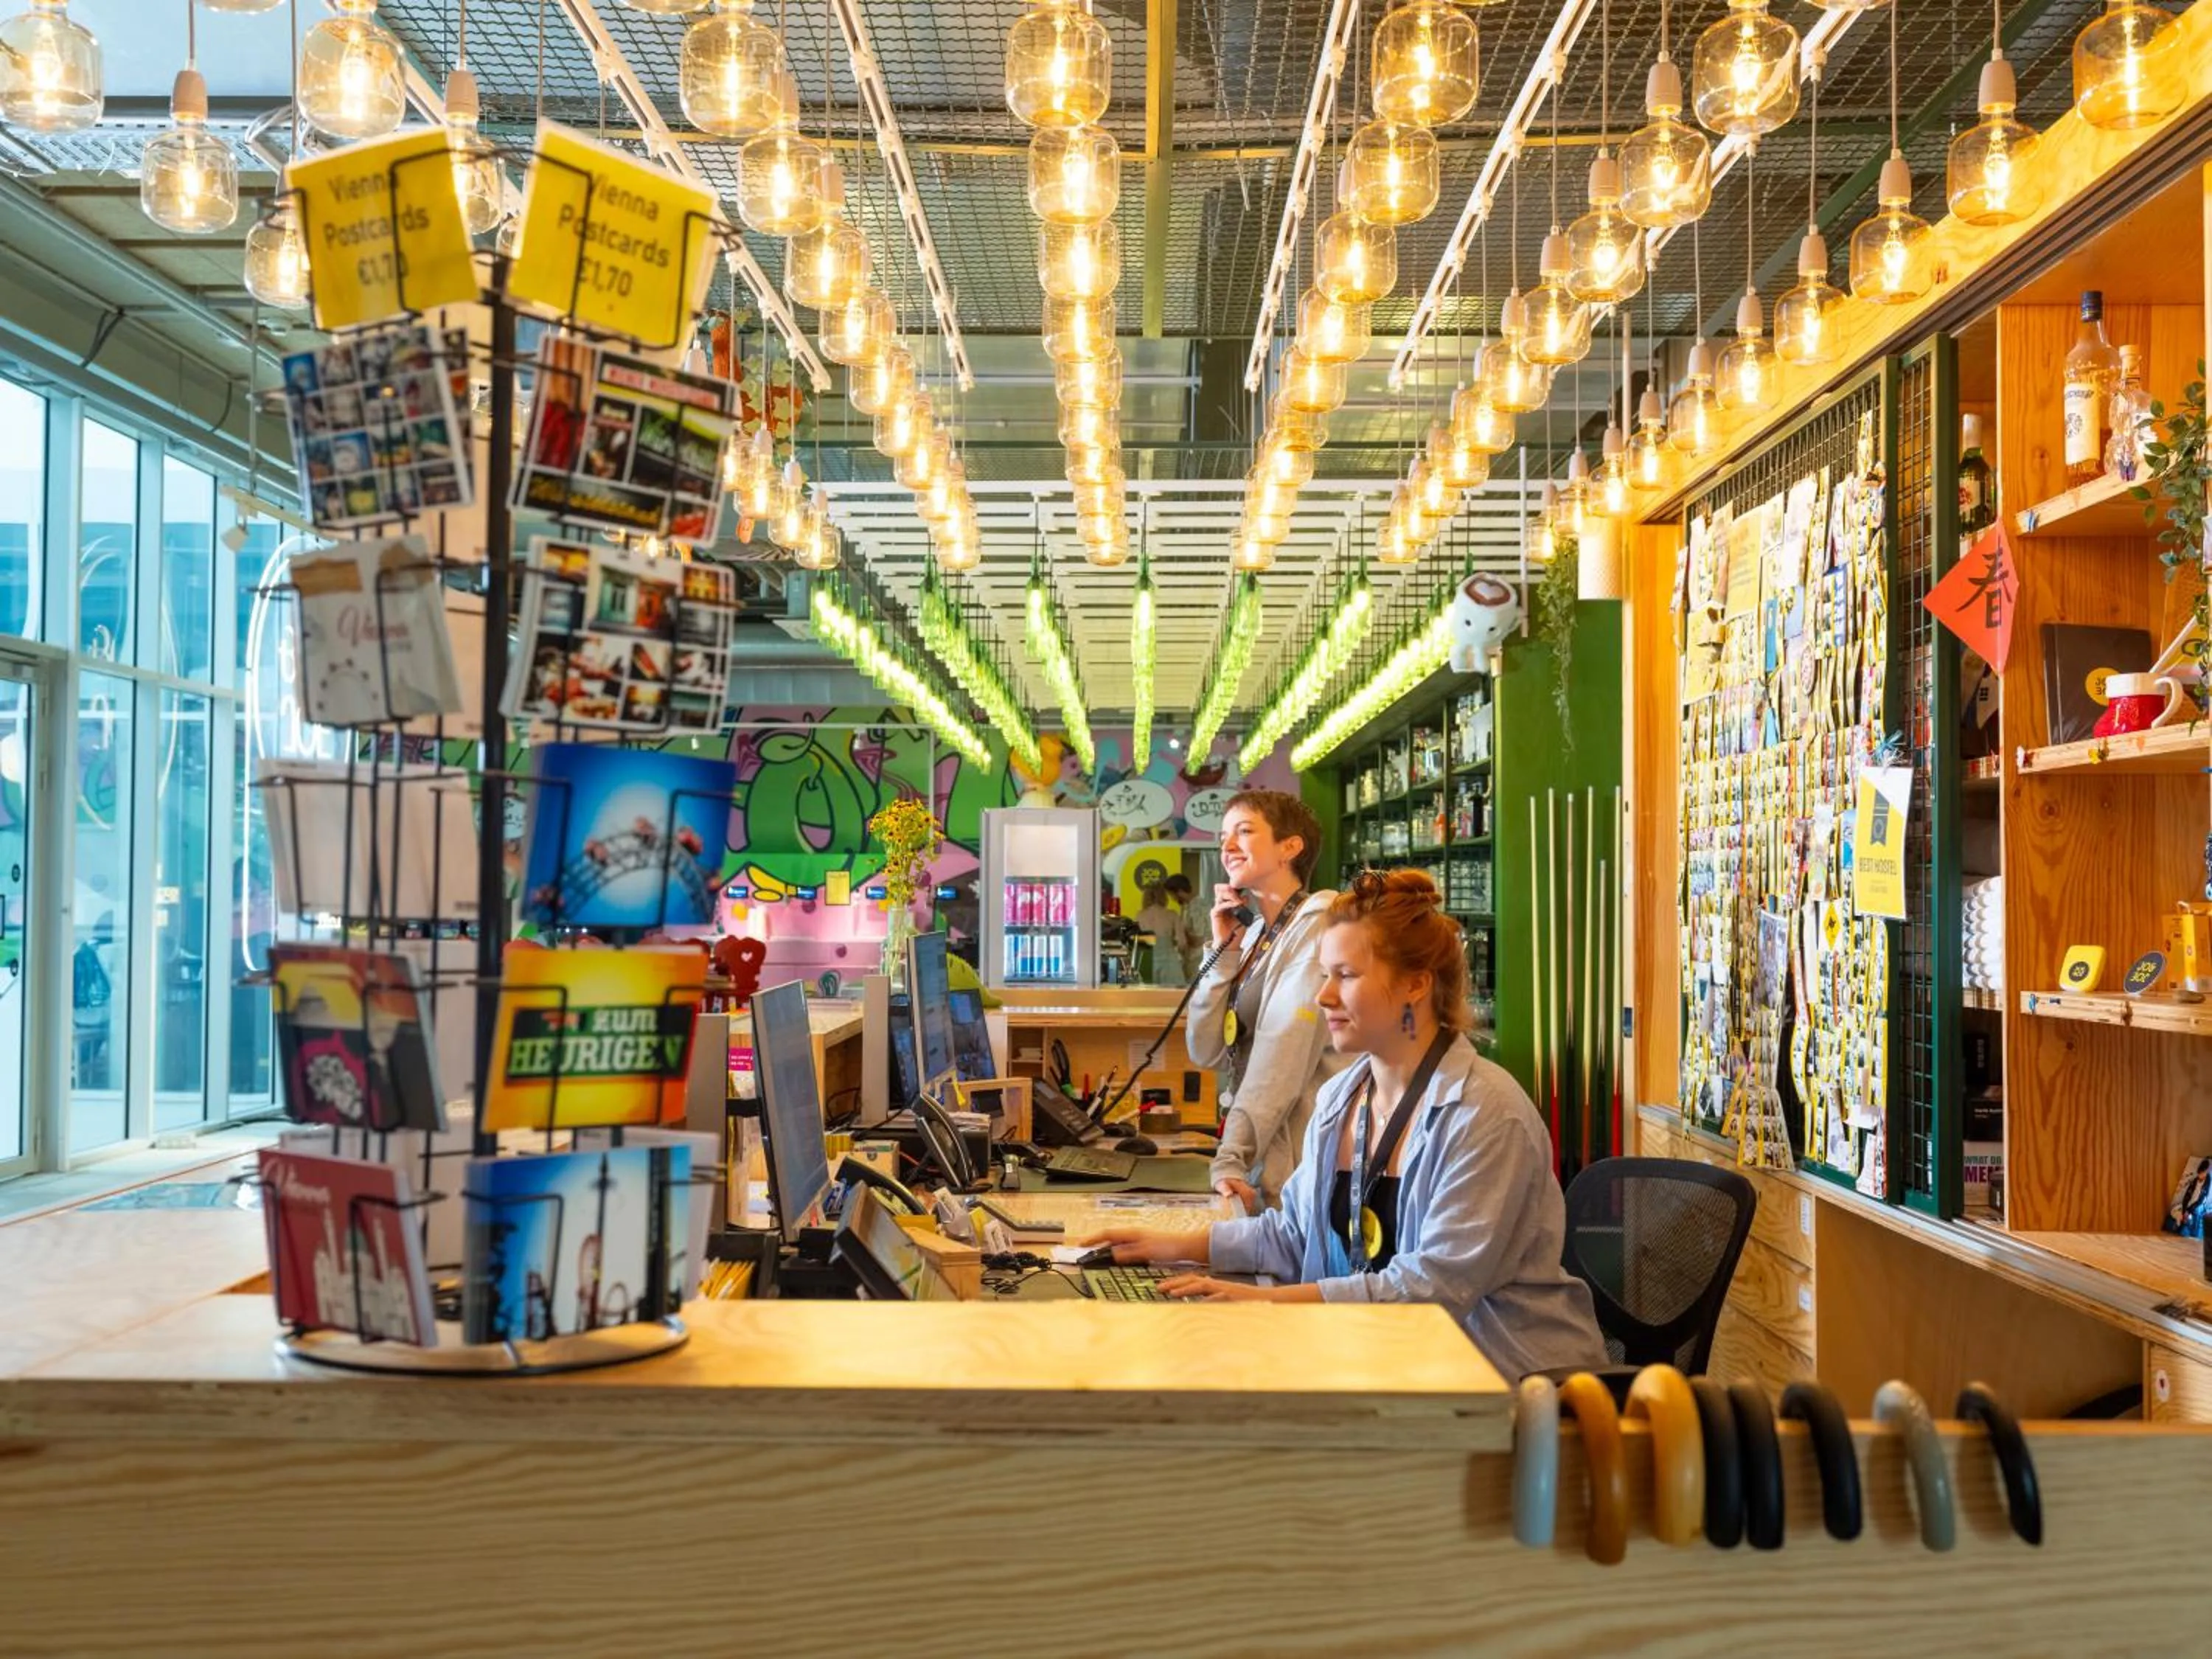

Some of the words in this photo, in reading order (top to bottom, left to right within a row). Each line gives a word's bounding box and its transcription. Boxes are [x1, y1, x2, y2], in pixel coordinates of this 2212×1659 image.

[327, 171, 400, 204] Vienn
[323, 203, 431, 251] Postcads
[557, 202, 672, 268] Postcards
[1955, 534, 2013, 628] 春
